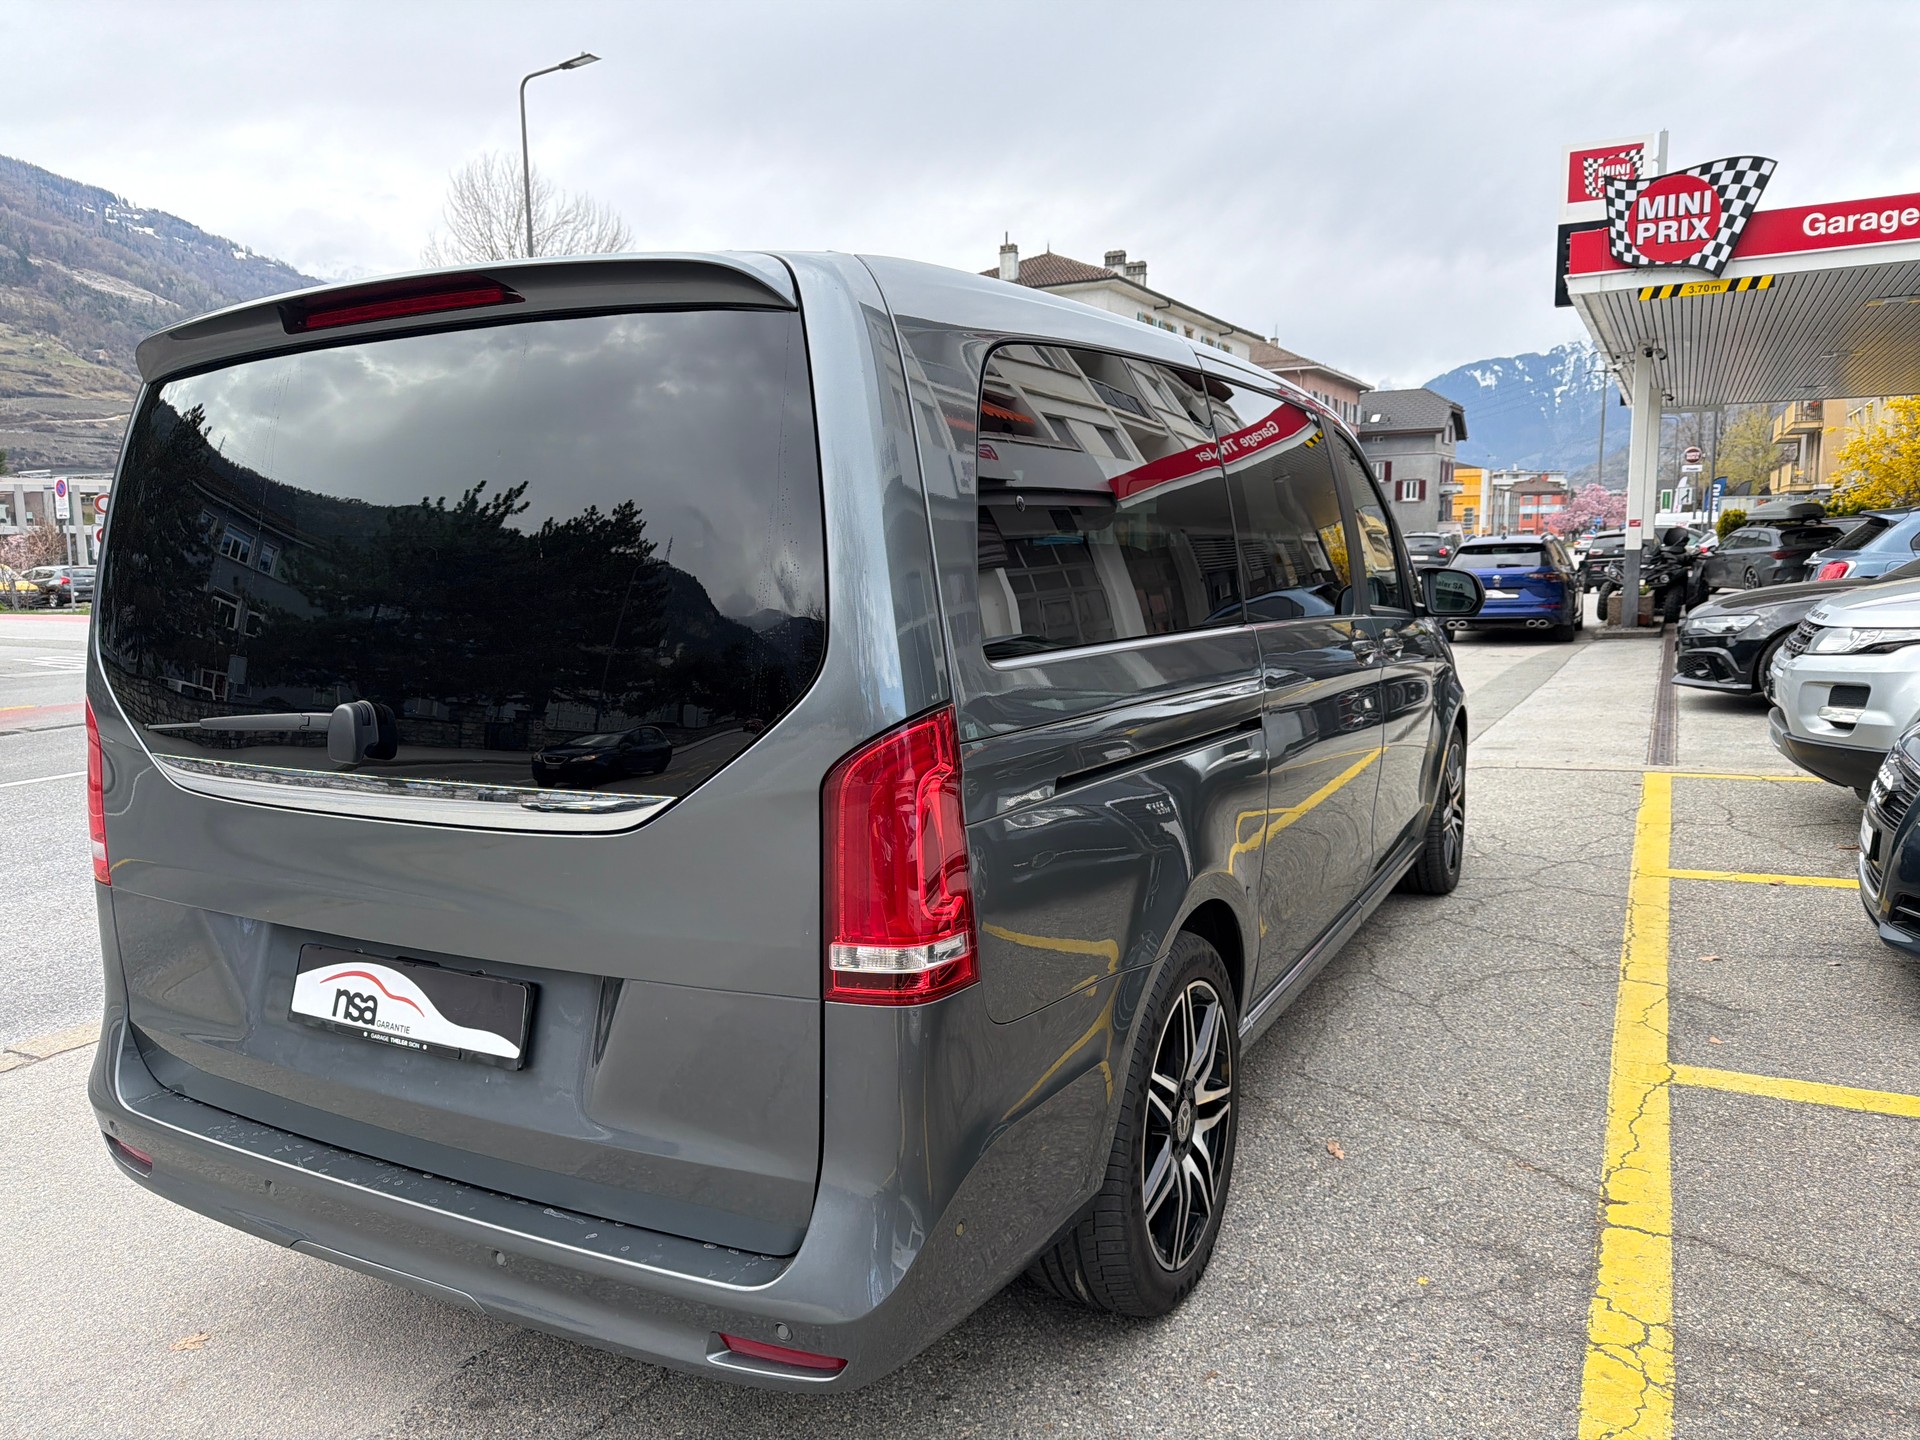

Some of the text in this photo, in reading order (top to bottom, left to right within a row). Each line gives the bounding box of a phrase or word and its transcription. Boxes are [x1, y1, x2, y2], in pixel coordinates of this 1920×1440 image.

[1598, 163, 1630, 177] MINI
[1638, 190, 1712, 220] MINI
[1636, 216, 1711, 245] PRIX
[1803, 207, 1920, 237] Garage
[1688, 284, 1710, 294] 3.70
[332, 988, 378, 1026] nsa
[370, 1032, 390, 1042] GARAGE
[377, 1020, 411, 1034] GARANTIE
